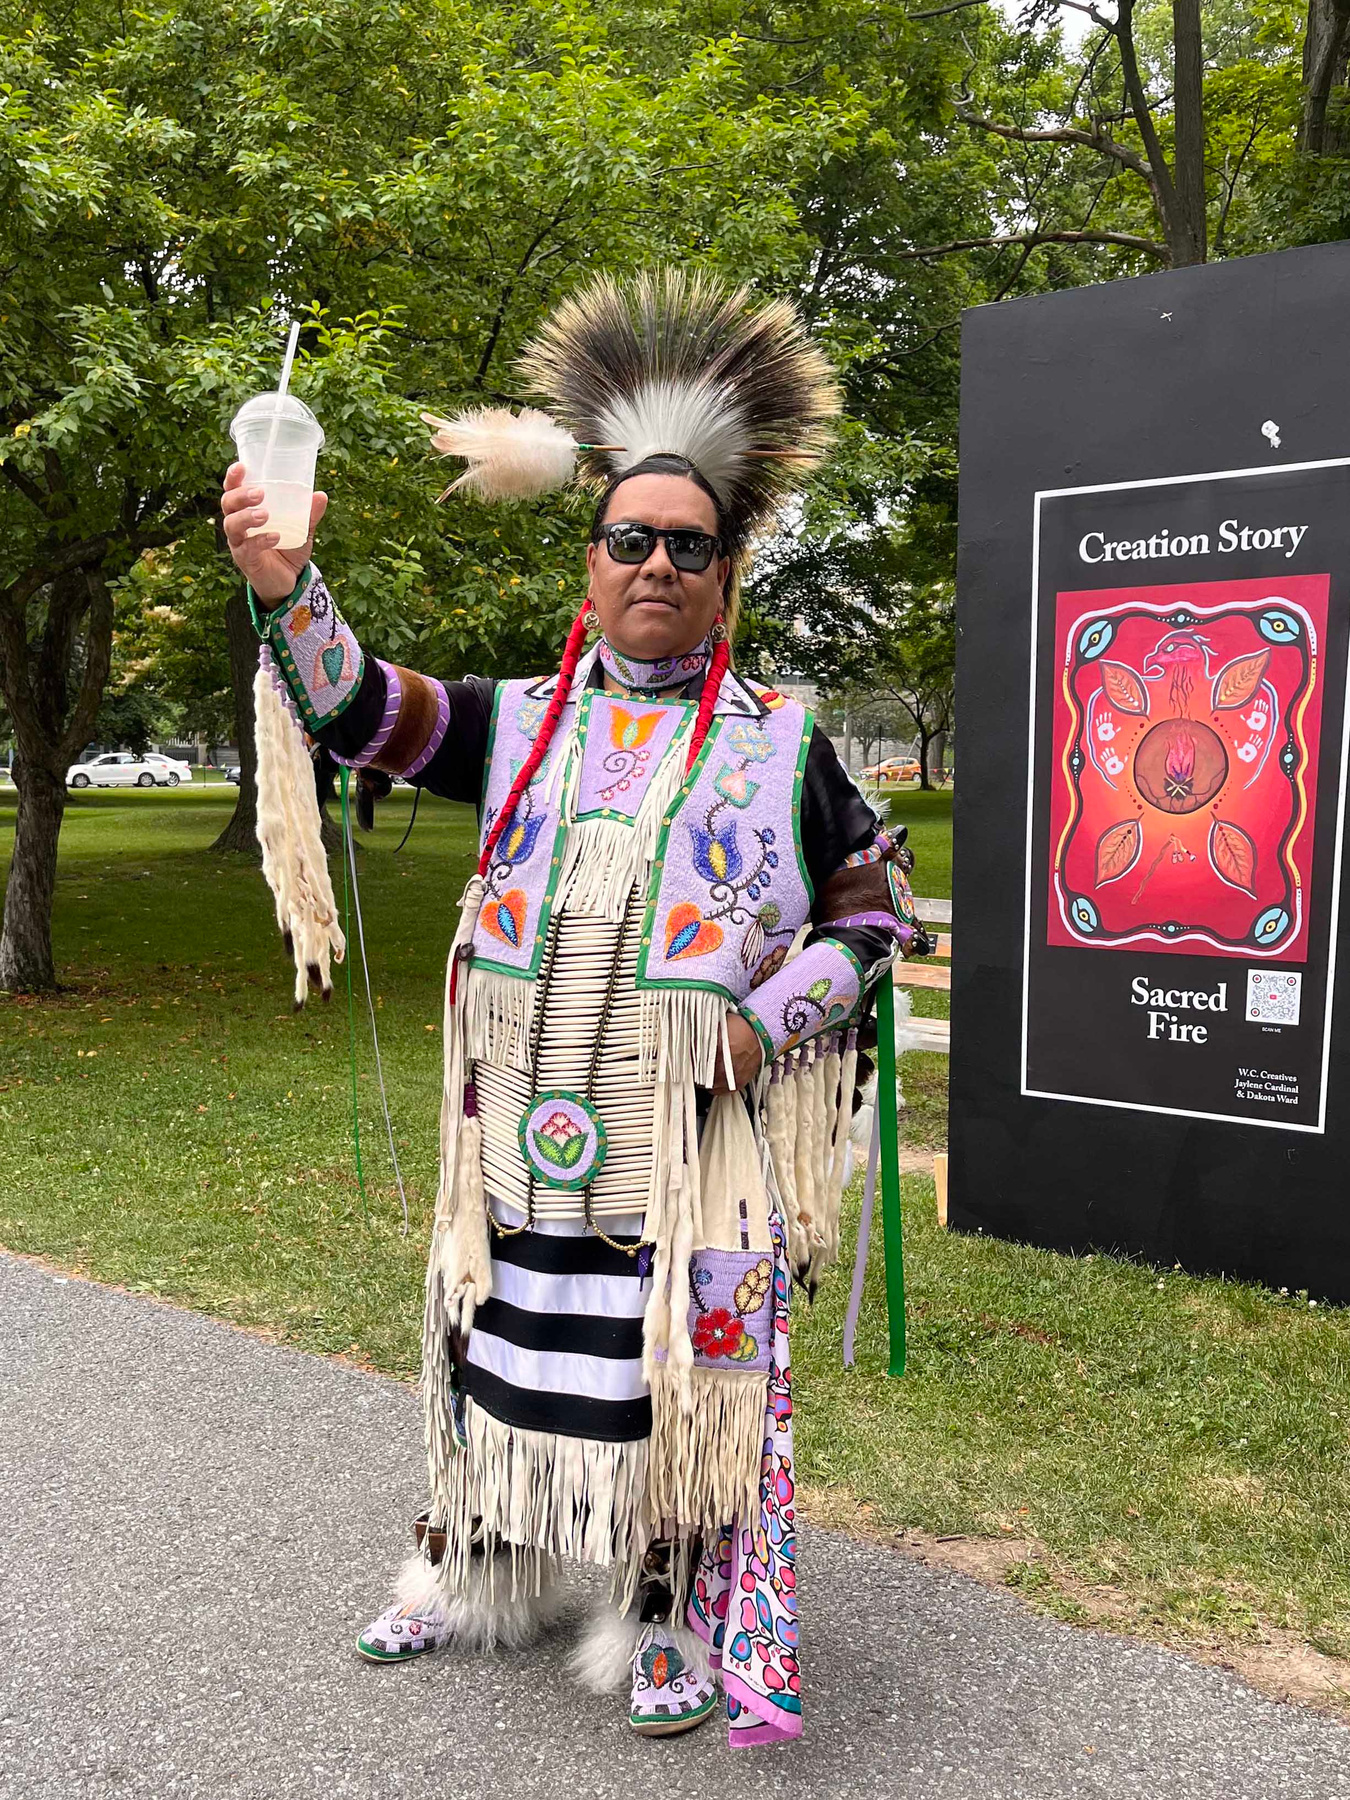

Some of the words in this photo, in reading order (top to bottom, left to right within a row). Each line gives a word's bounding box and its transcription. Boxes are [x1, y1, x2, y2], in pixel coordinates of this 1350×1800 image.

[1078, 529, 1210, 563] Creation
[1218, 519, 1309, 558] Story
[1131, 976, 1228, 1012] Sacred
[1147, 1011, 1208, 1044] Fire
[1234, 1078, 1264, 1090] Jaylene
[1264, 1082, 1299, 1094] Cardinal
[1238, 1067, 1259, 1078] W.C.
[1260, 1070, 1297, 1082] Creatives
[1236, 1089, 1245, 1099] &
[1246, 1090, 1276, 1102] Dakota
[1276, 1094, 1299, 1105] Ward
